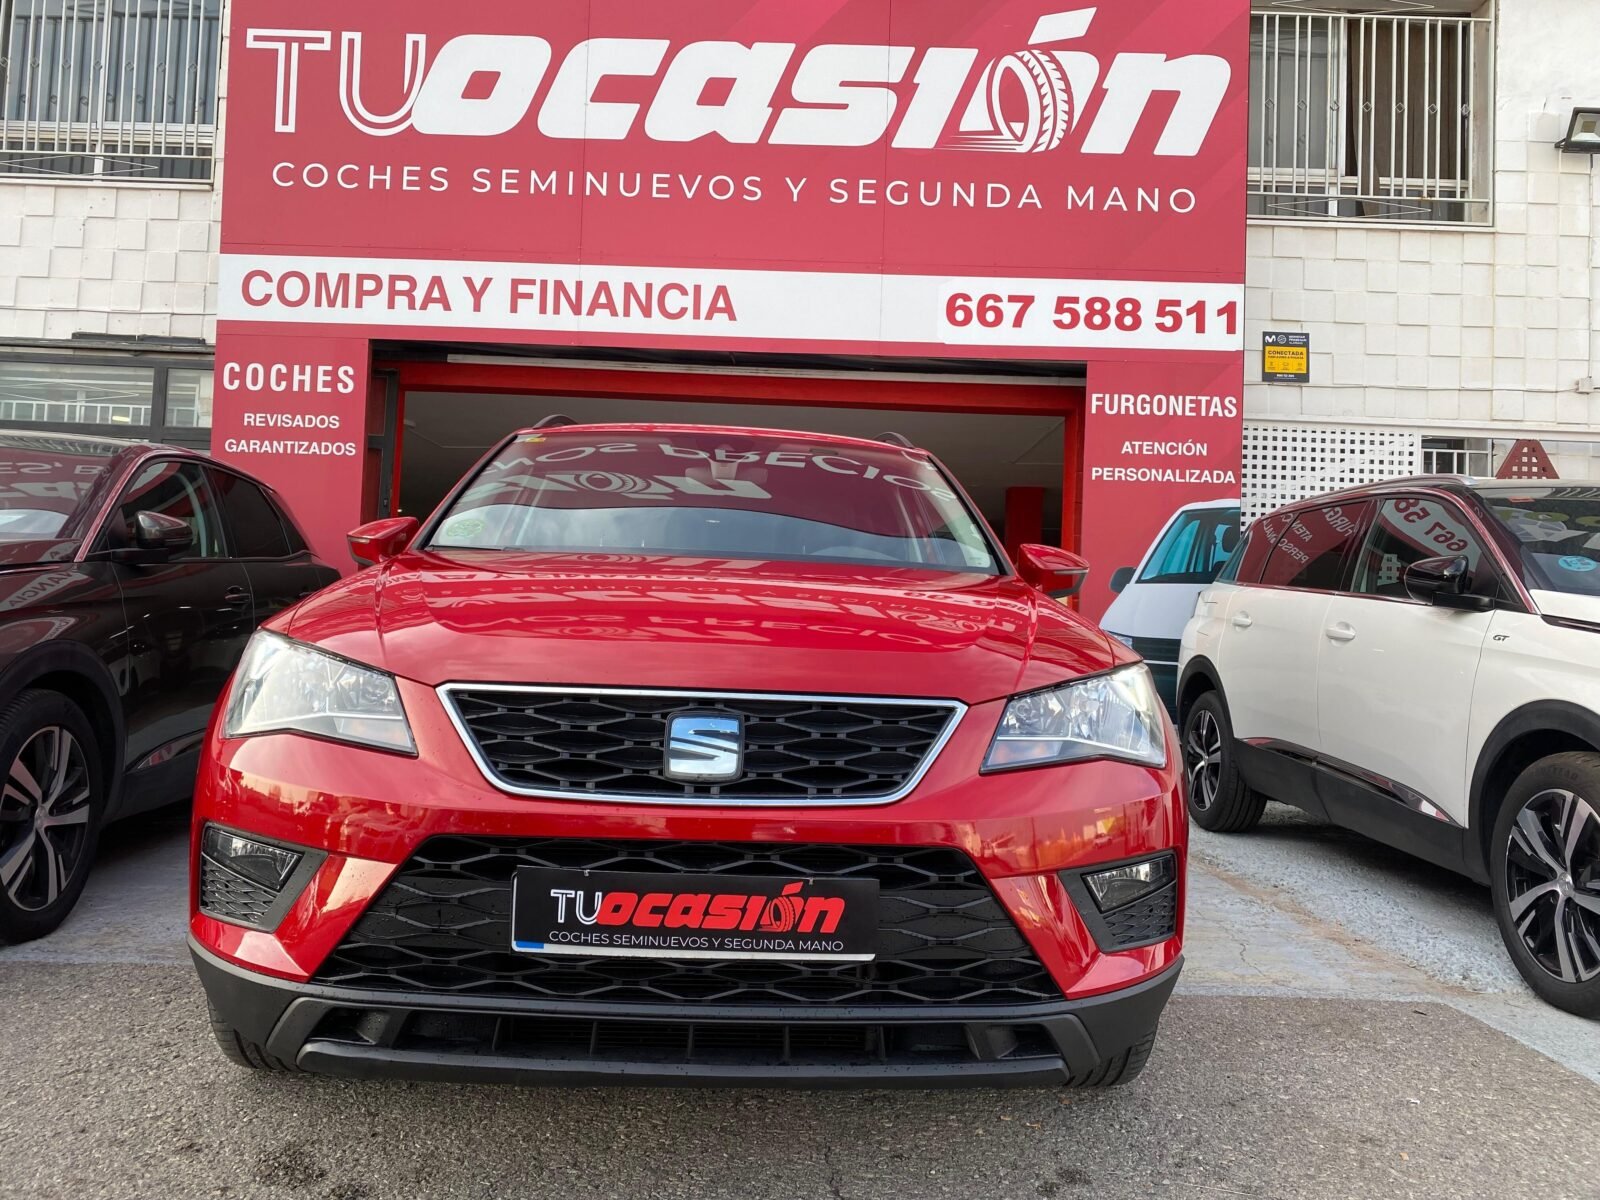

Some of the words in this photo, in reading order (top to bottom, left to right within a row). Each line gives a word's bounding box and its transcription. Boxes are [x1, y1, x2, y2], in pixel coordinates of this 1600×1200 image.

[272, 161, 449, 193] COCHES
[472, 167, 762, 202] SEMINUEVOS
[785, 177, 807, 203] Y
[829, 178, 1043, 210] SEGUNDA
[1067, 187, 1197, 214] MANO
[241, 269, 452, 311] COMPRA
[463, 277, 493, 313] Y
[509, 278, 737, 322] FINANCIA
[945, 292, 1035, 329] 667
[1053, 295, 1142, 332] 588
[1155, 299, 1237, 335] 511
[222, 361, 355, 394] COCHES
[1090, 393, 1238, 418] FURGONETAS
[243, 412, 340, 429] REVISADOS
[224, 439, 356, 456] GARANTIZADOS
[1121, 438, 1208, 457] ATENCIÓN
[1091, 467, 1236, 485] PERSONALIZADA
[1492, 634, 1511, 642] GT
[549, 930, 610, 945] COCHES
[612, 934, 709, 949] SEMINUEVOS
[712, 937, 722, 948] Y
[724, 938, 796, 951] SEGUNDA
[799, 940, 844, 952] MANO
